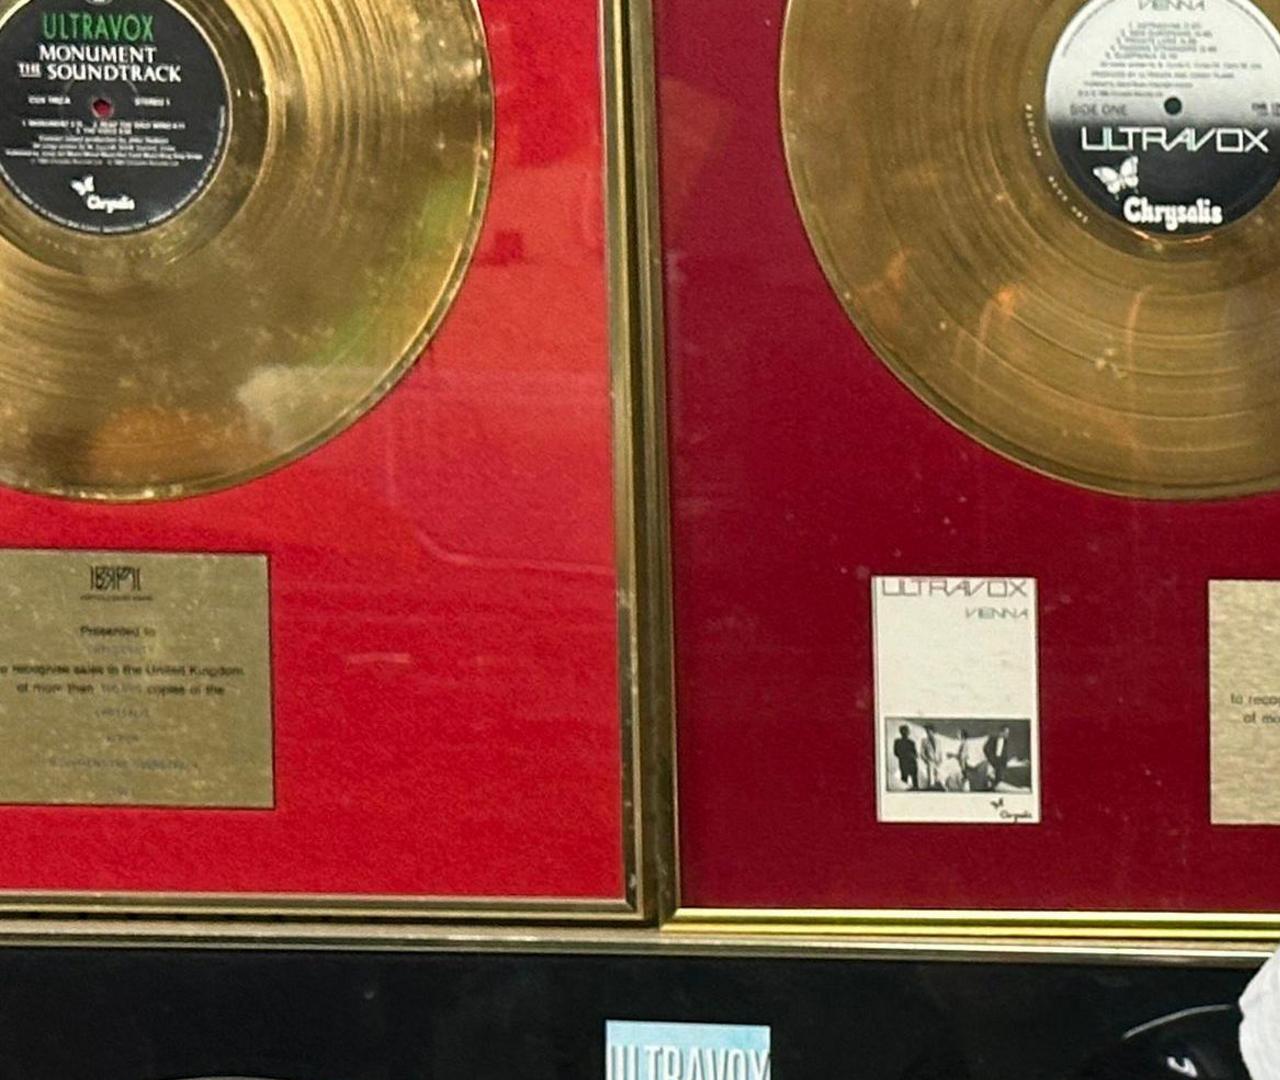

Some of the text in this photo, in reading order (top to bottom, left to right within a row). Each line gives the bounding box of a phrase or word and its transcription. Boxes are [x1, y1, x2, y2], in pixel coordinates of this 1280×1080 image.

[43, 13, 154, 41] ULTRAVOX
[39, 45, 157, 63] MONUMENT
[47, 64, 181, 82] SOUNDTRACK
[1070, 103, 1097, 115] SIDE
[1102, 103, 1128, 116] ONE
[1081, 127, 1269, 152] ULTRAVOX
[1123, 196, 1223, 230] Chrysalis
[882, 579, 1028, 597] ULTRAVOX
[965, 606, 1029, 620] VIENNA
[1243, 712, 1257, 724] of
